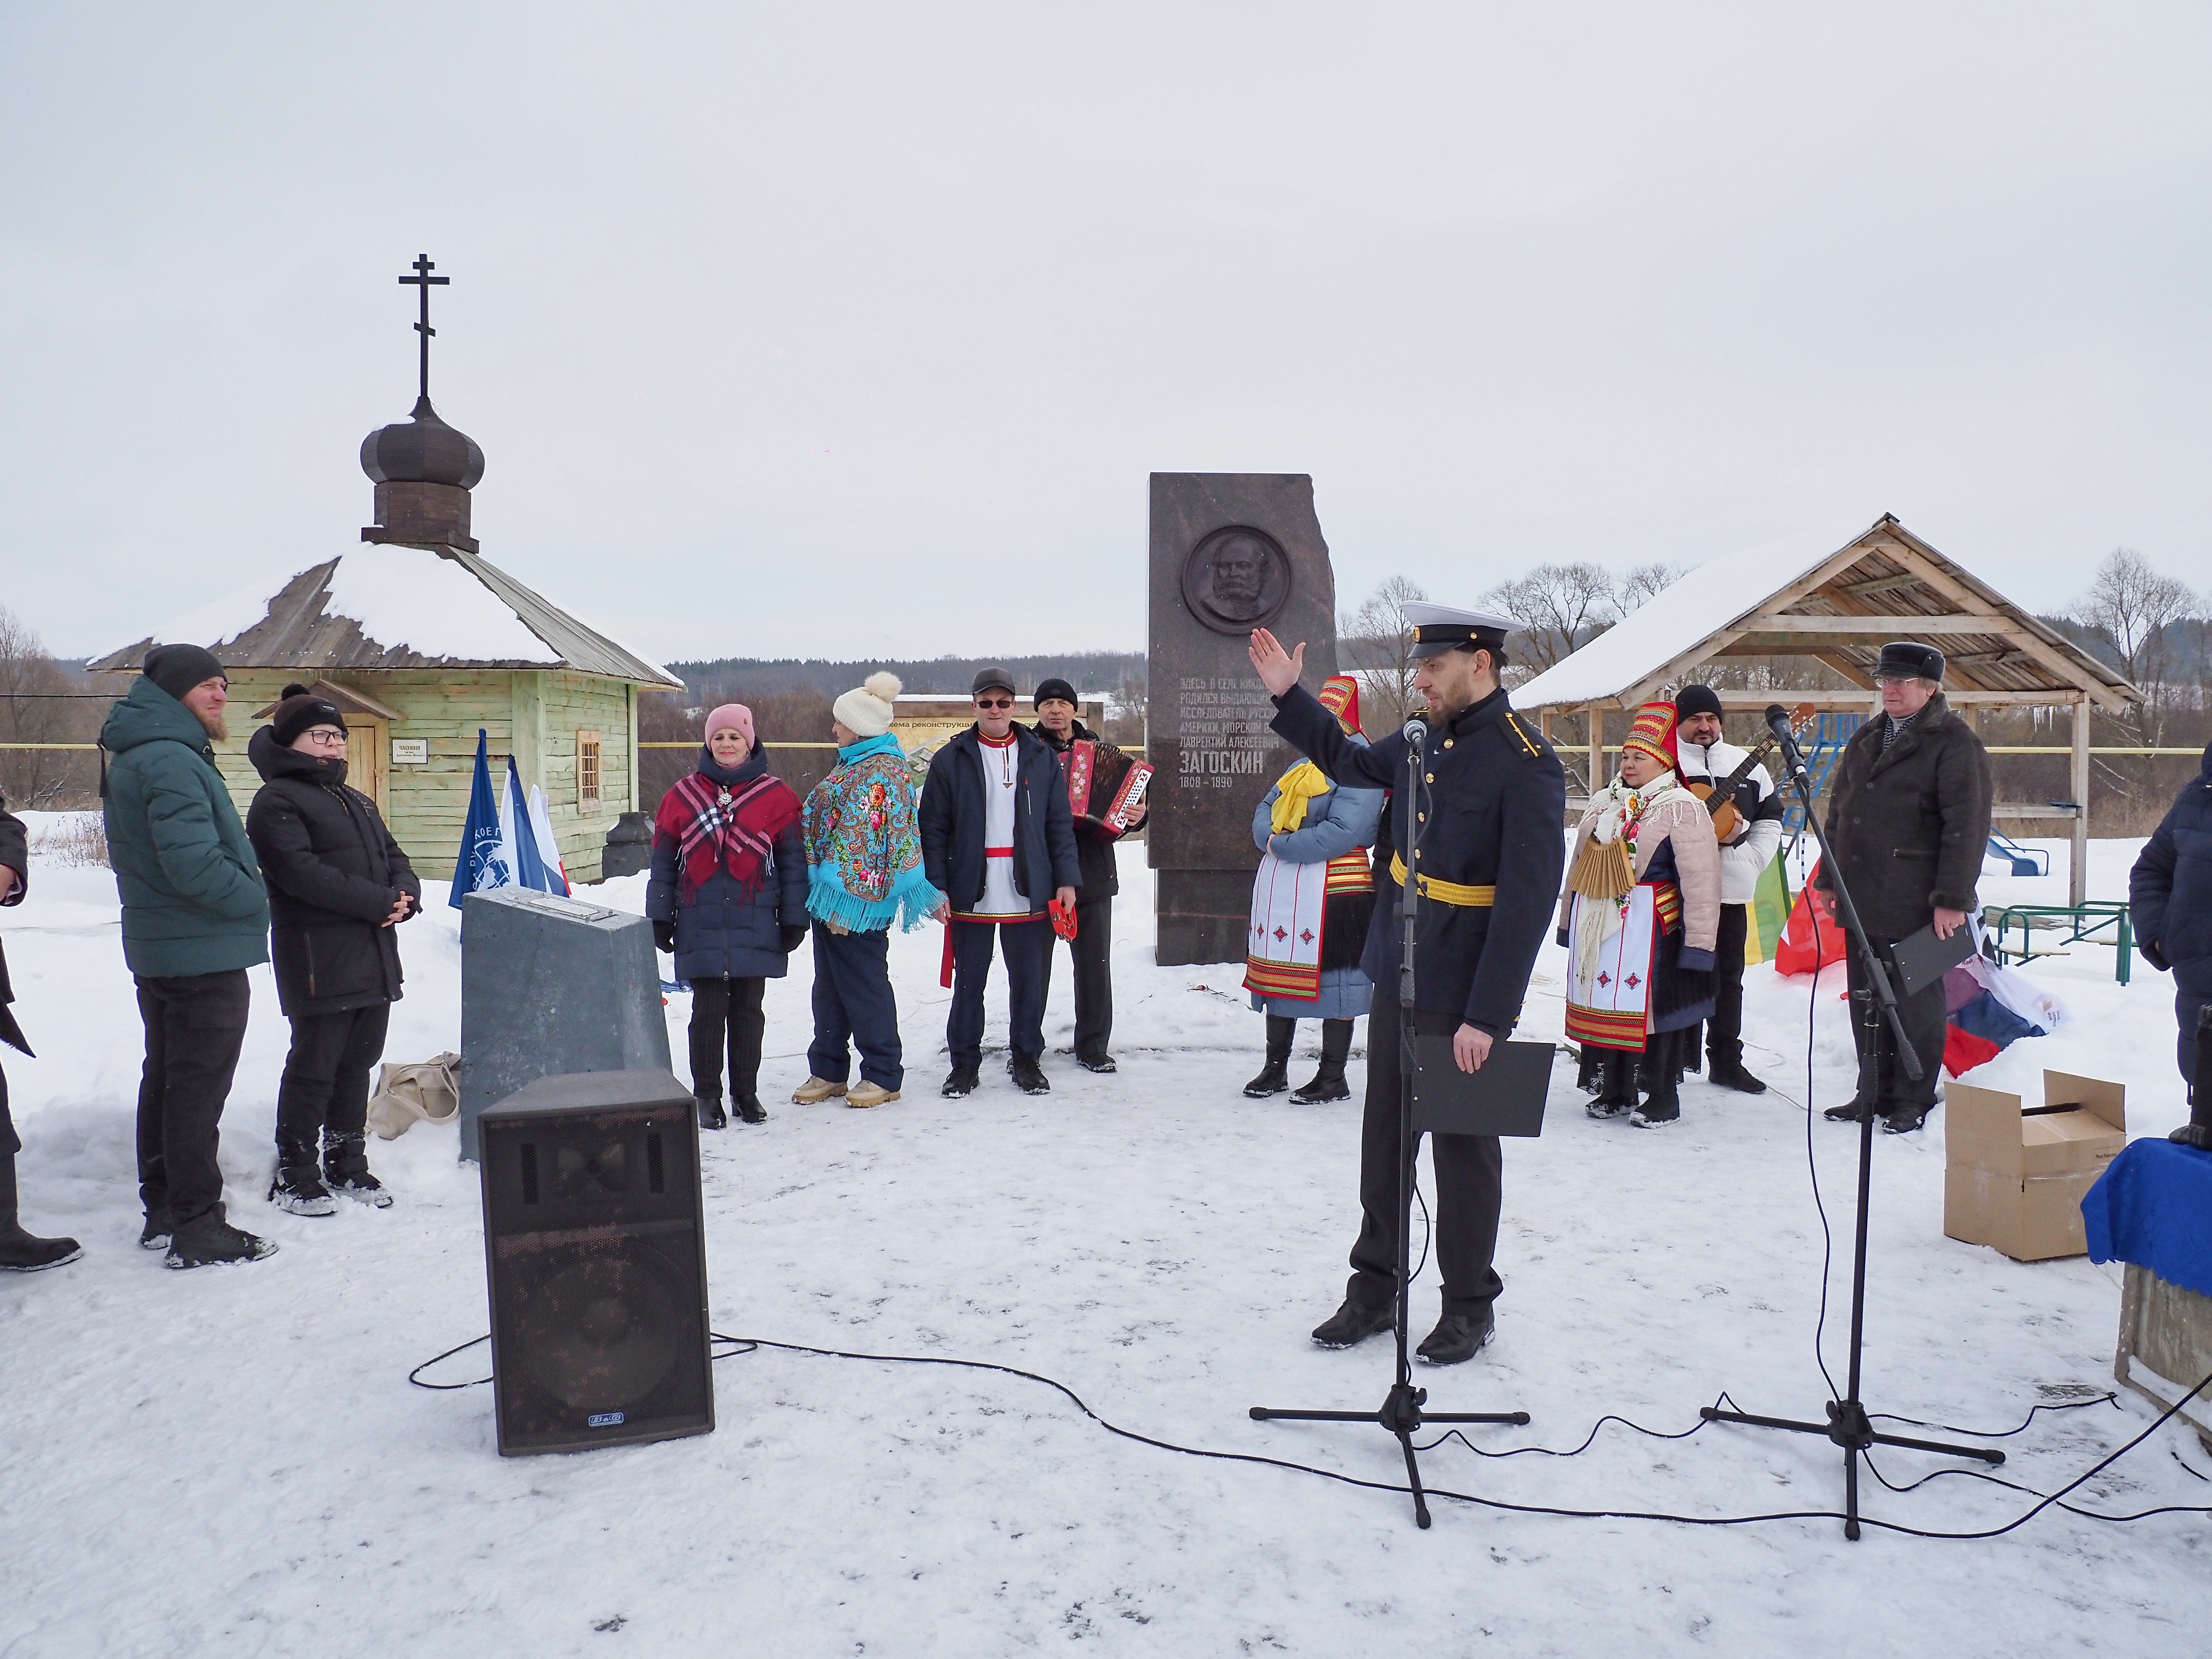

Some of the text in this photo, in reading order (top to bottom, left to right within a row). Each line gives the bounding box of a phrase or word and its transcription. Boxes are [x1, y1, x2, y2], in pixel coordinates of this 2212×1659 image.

[1210, 678, 1215, 690] В
[1218, 678, 1237, 690] СЕЛЕ
[1240, 678, 1267, 690] НИКОЛ
[1180, 693, 1218, 705] РОДИЛСЯ
[1180, 707, 1246, 720] ИССЛЕДОВАТЕЛЬ
[1222, 719, 1261, 733] МОРСКОЙ
[1179, 733, 1279, 748] ЛАВРЕНТИЙ АЛЕКСЕЕВИЧ
[1179, 750, 1263, 774] ЗАГОСКИН
[1179, 776, 1201, 788] 1808
[1211, 776, 1233, 788] 1890
